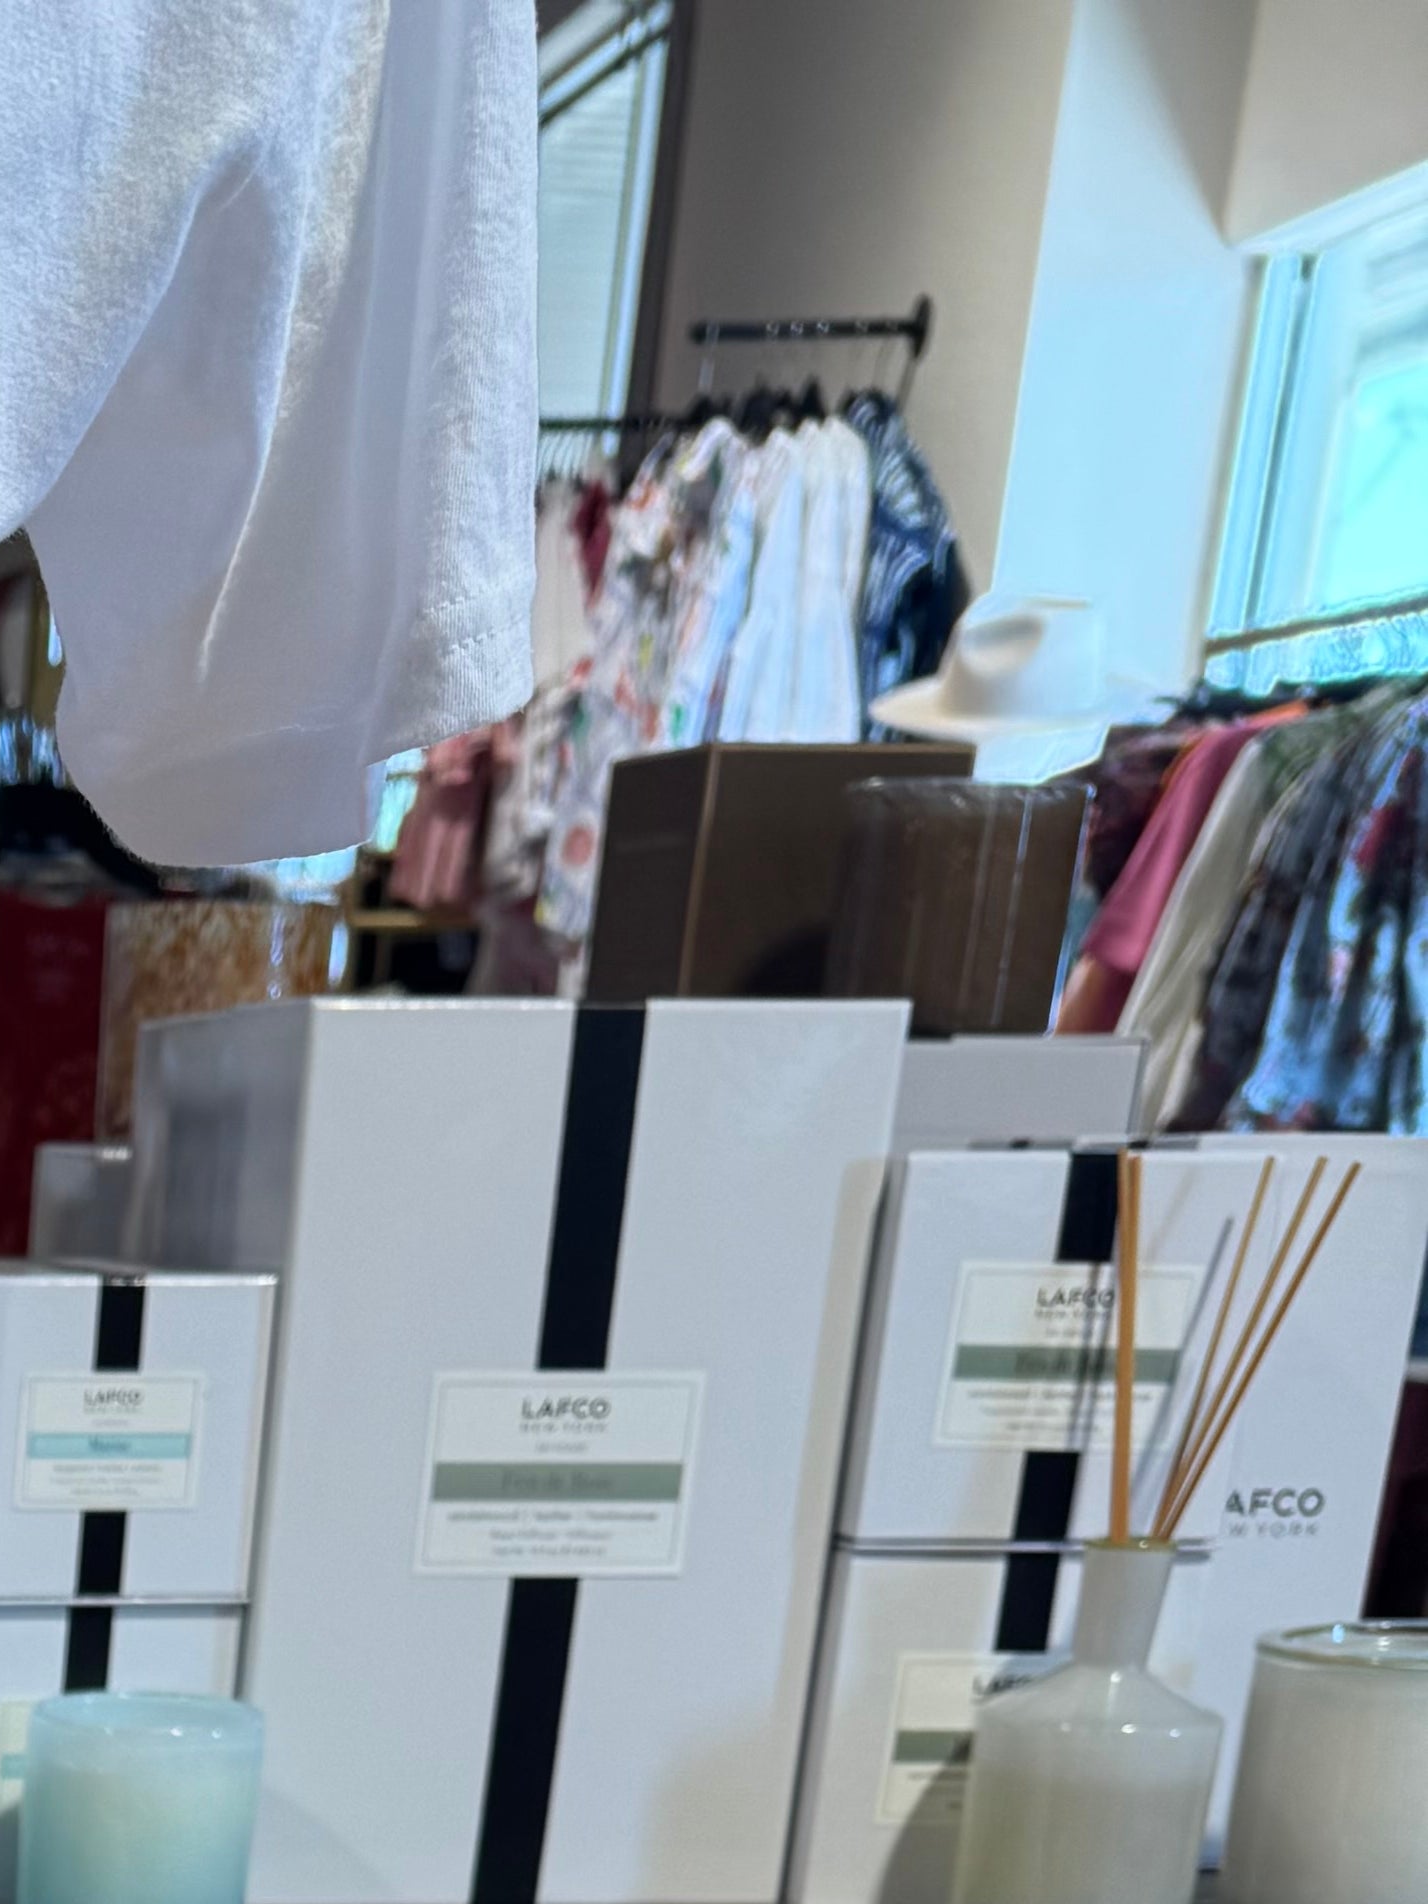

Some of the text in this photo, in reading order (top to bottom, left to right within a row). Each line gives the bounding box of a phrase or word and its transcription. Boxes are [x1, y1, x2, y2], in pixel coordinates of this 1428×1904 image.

[1036, 1287, 1115, 1309] LAFCO
[521, 1398, 612, 1420] LAFCO
[1225, 1487, 1326, 1518] AFCO
